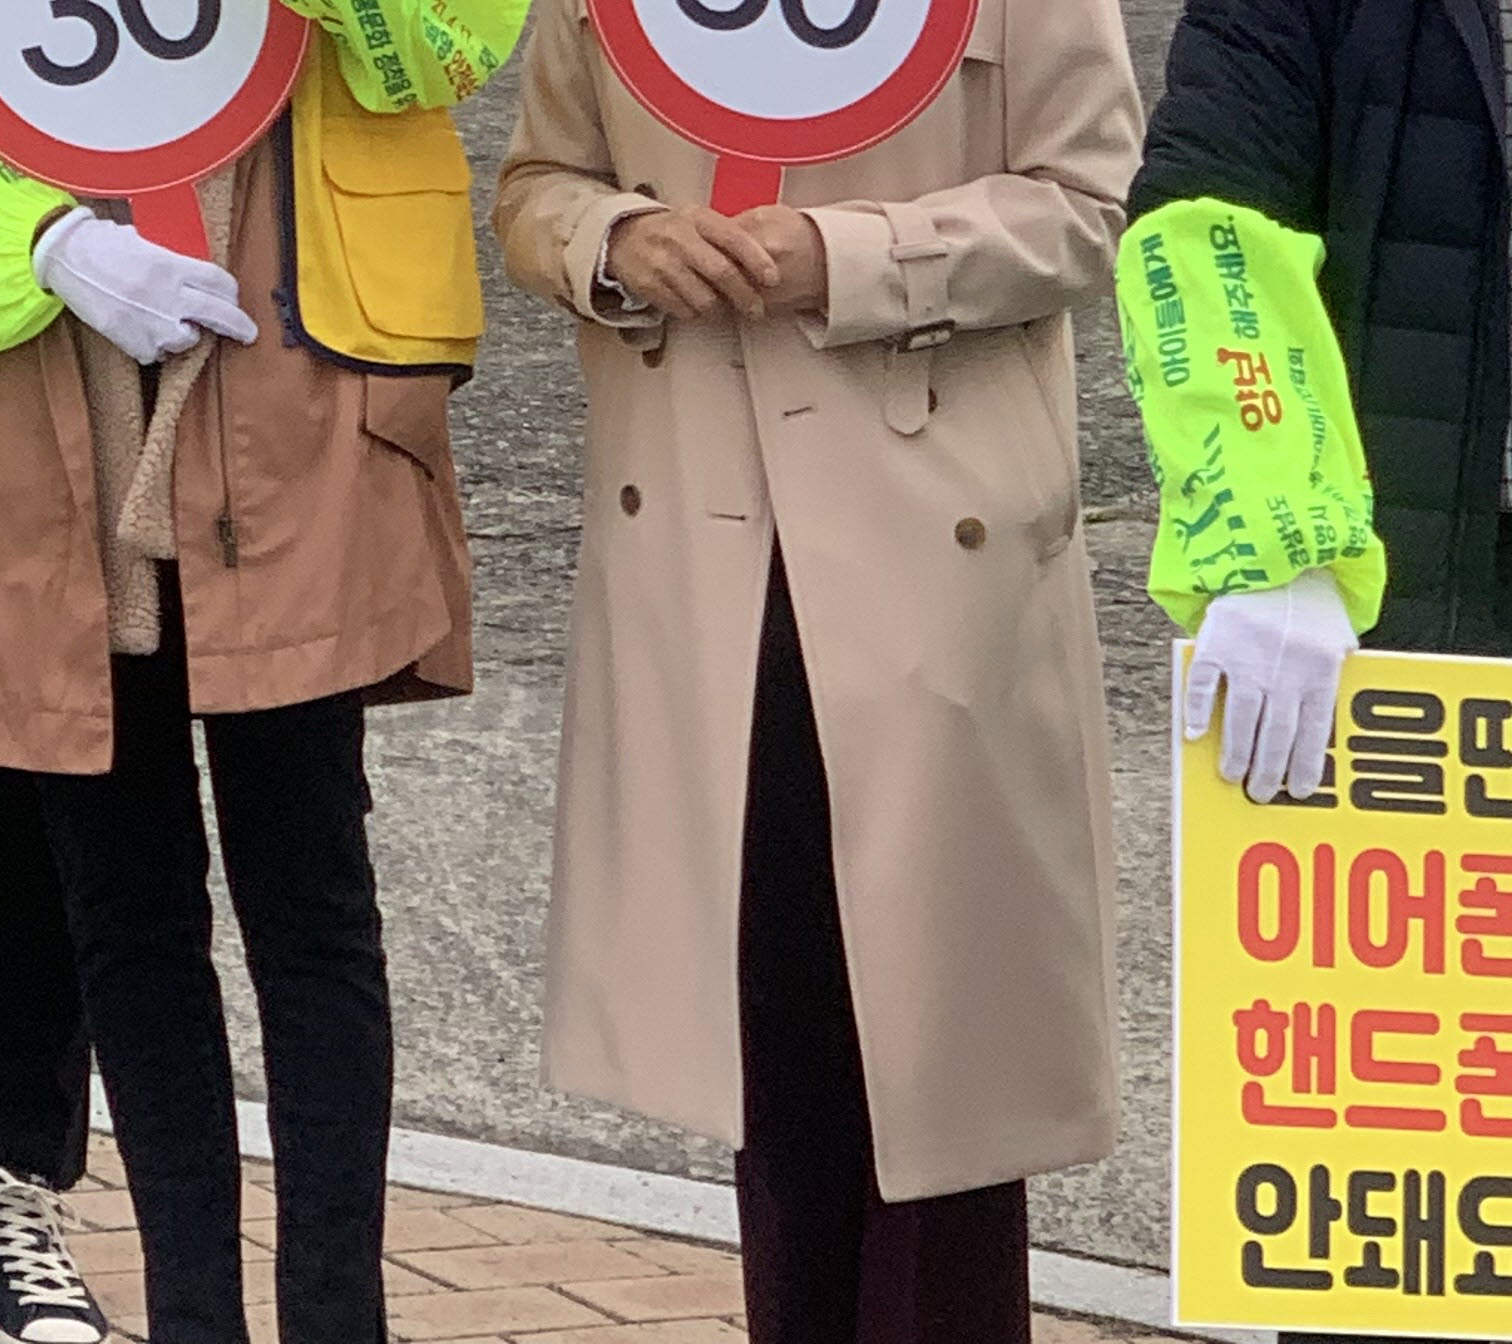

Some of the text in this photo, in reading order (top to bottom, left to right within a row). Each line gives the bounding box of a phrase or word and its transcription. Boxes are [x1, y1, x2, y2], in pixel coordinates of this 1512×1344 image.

[1139, 232, 1191, 388] 아이들에게
[1208, 213, 1283, 433] 양보 해주세요.
